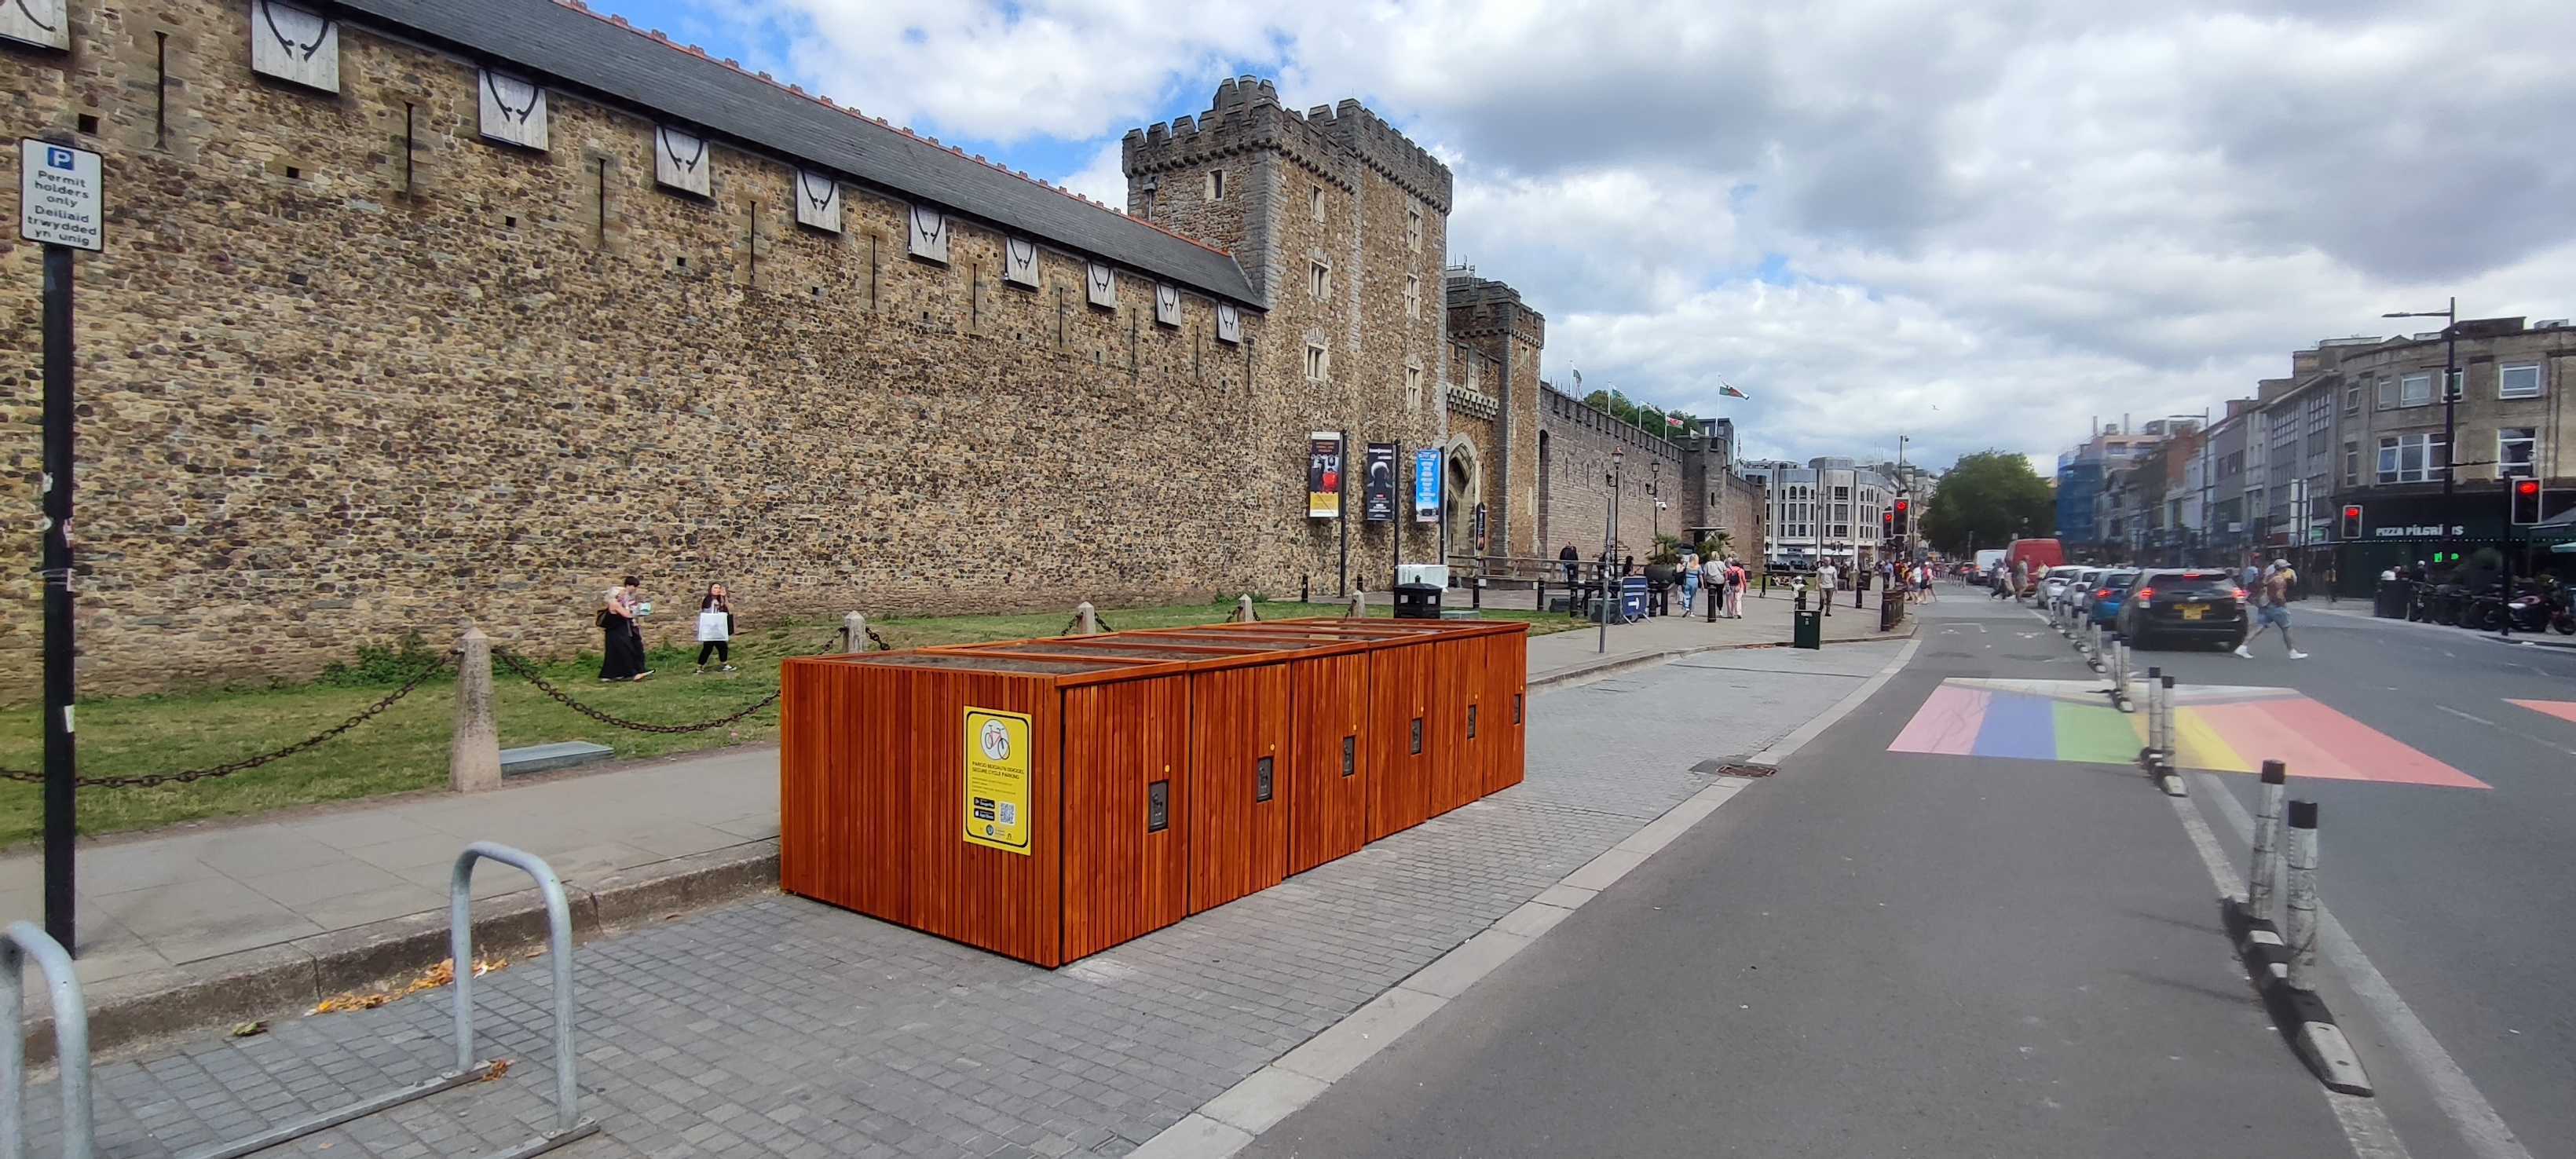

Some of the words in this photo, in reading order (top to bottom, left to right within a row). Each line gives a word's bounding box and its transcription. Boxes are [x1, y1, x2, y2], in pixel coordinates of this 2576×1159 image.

[53, 151, 71, 166] P
[38, 170, 86, 188] Permit
[35, 181, 89, 199] holders
[46, 196, 78, 207] only
[35, 205, 89, 223] Deiliaid
[27, 216, 97, 236] trwydded
[35, 229, 51, 238] yn
[59, 233, 90, 246] unig
[2376, 527, 2403, 536] PIZZA
[2406, 524, 2464, 536] PILGRIS
